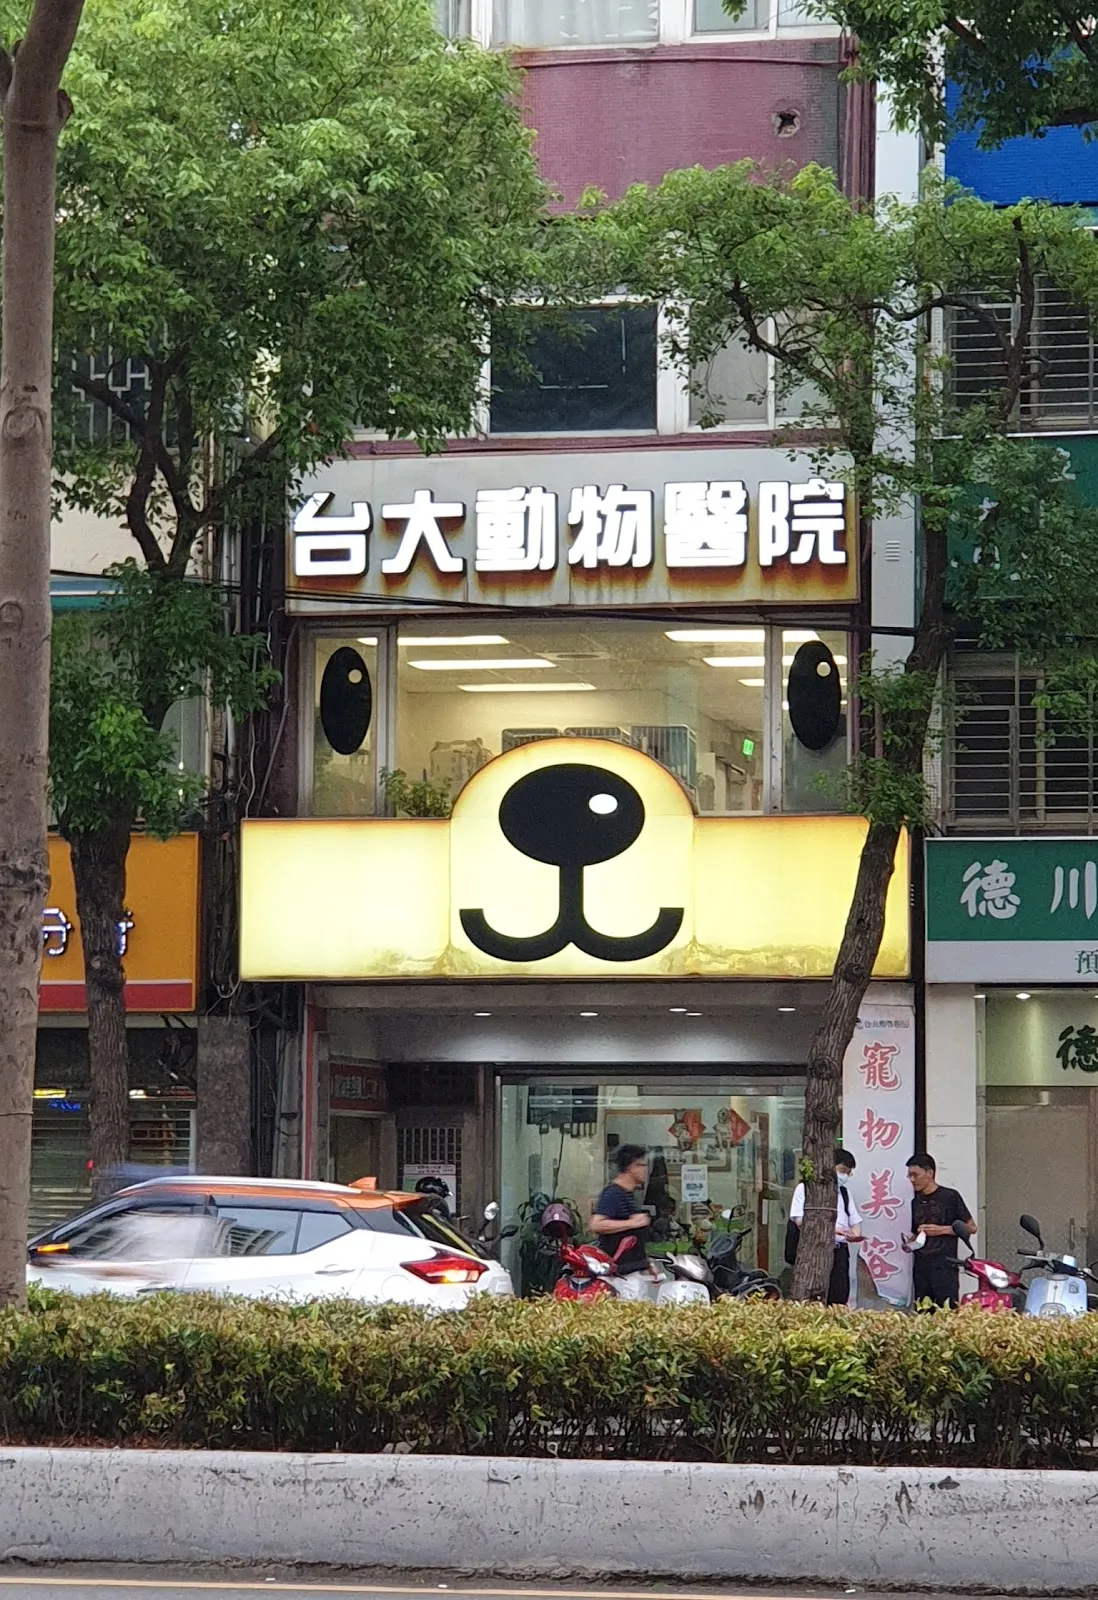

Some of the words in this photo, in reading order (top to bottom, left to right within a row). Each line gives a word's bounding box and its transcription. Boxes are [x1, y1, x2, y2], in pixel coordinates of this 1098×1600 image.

[293, 478, 848, 577] 台大動物醫院
[960, 859, 1098, 920] 德川
[858, 1041, 901, 1281] 寵物美容
